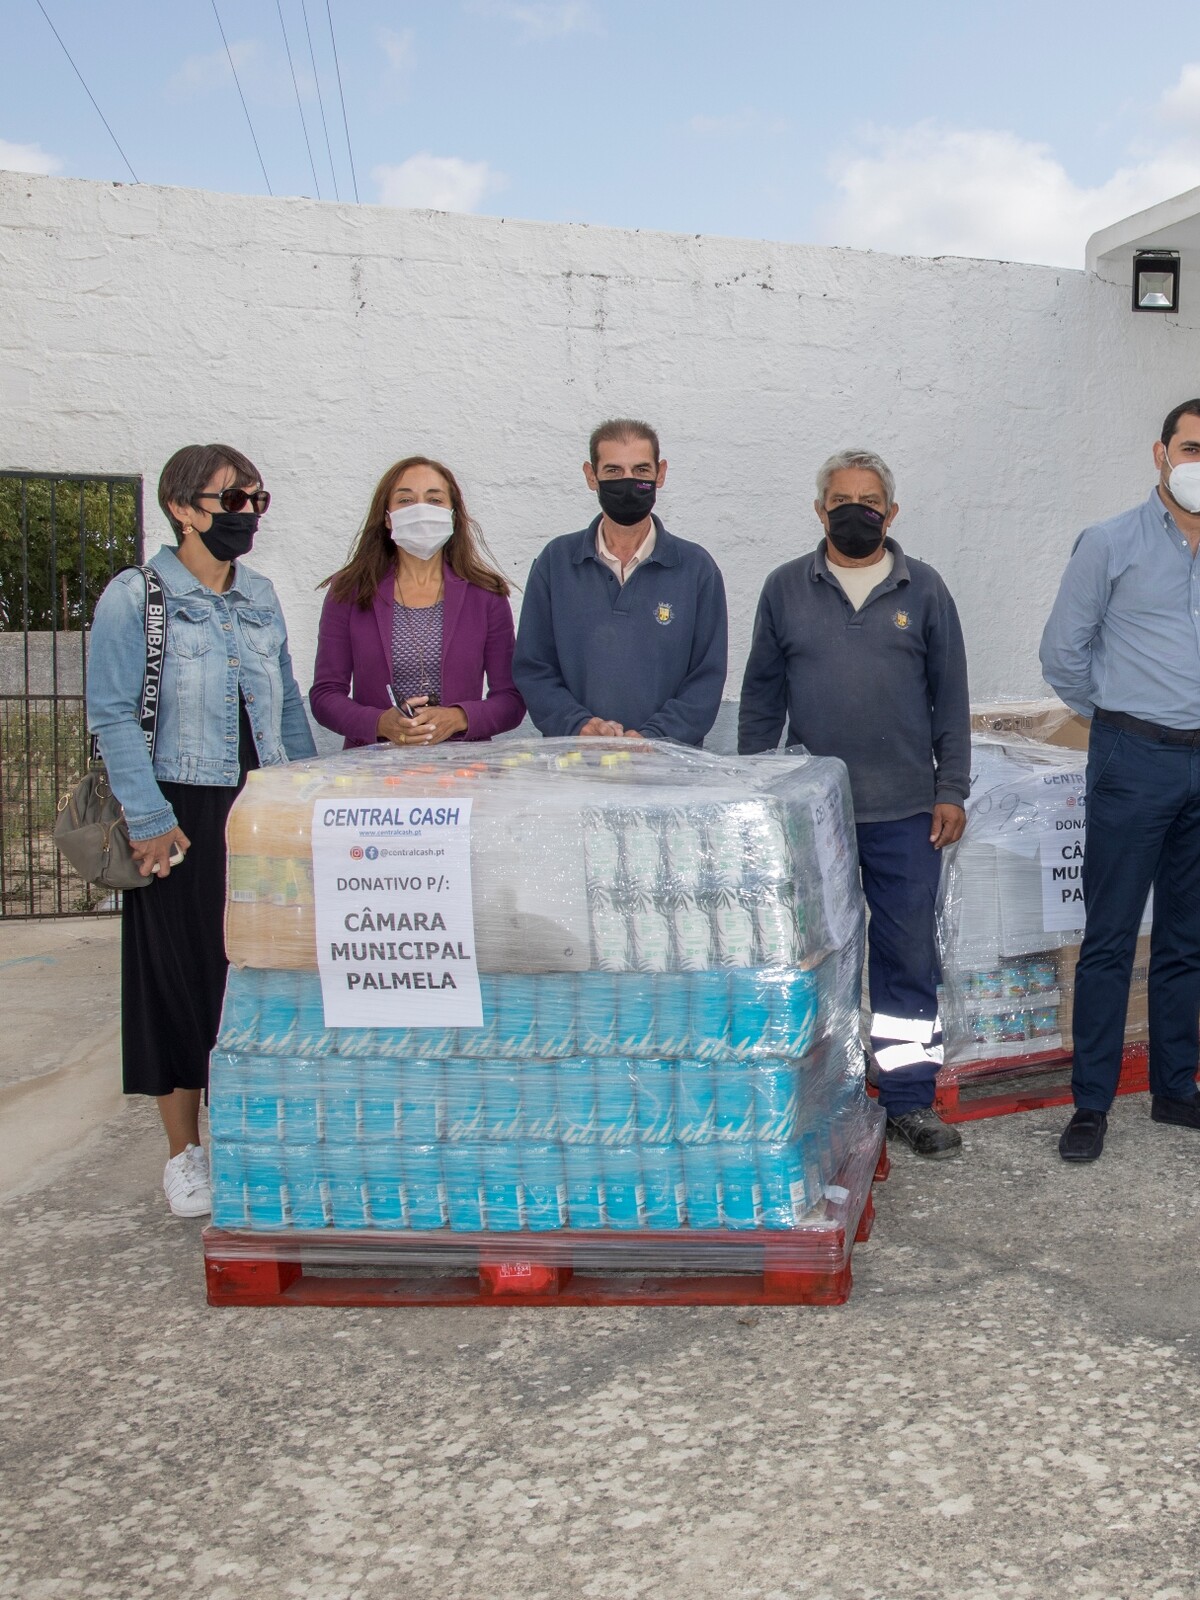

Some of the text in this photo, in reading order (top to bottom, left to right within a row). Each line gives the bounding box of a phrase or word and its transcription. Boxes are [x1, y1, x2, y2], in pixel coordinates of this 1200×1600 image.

[147, 604, 163, 658] BIMBA
[142, 676, 157, 719] LOLA
[1043, 773, 1085, 785] CENTR
[323, 807, 460, 827] CENTRAL CASH
[1055, 819, 1087, 831] DONA
[359, 829, 422, 837] www.centralcash.pt
[380, 848, 445, 857] @centralcash.pt
[337, 875, 450, 893] DONATIVO P/:
[344, 907, 447, 932] CÂMARA
[330, 941, 471, 961] MUNICIPAL
[346, 971, 457, 990] PALMELA
